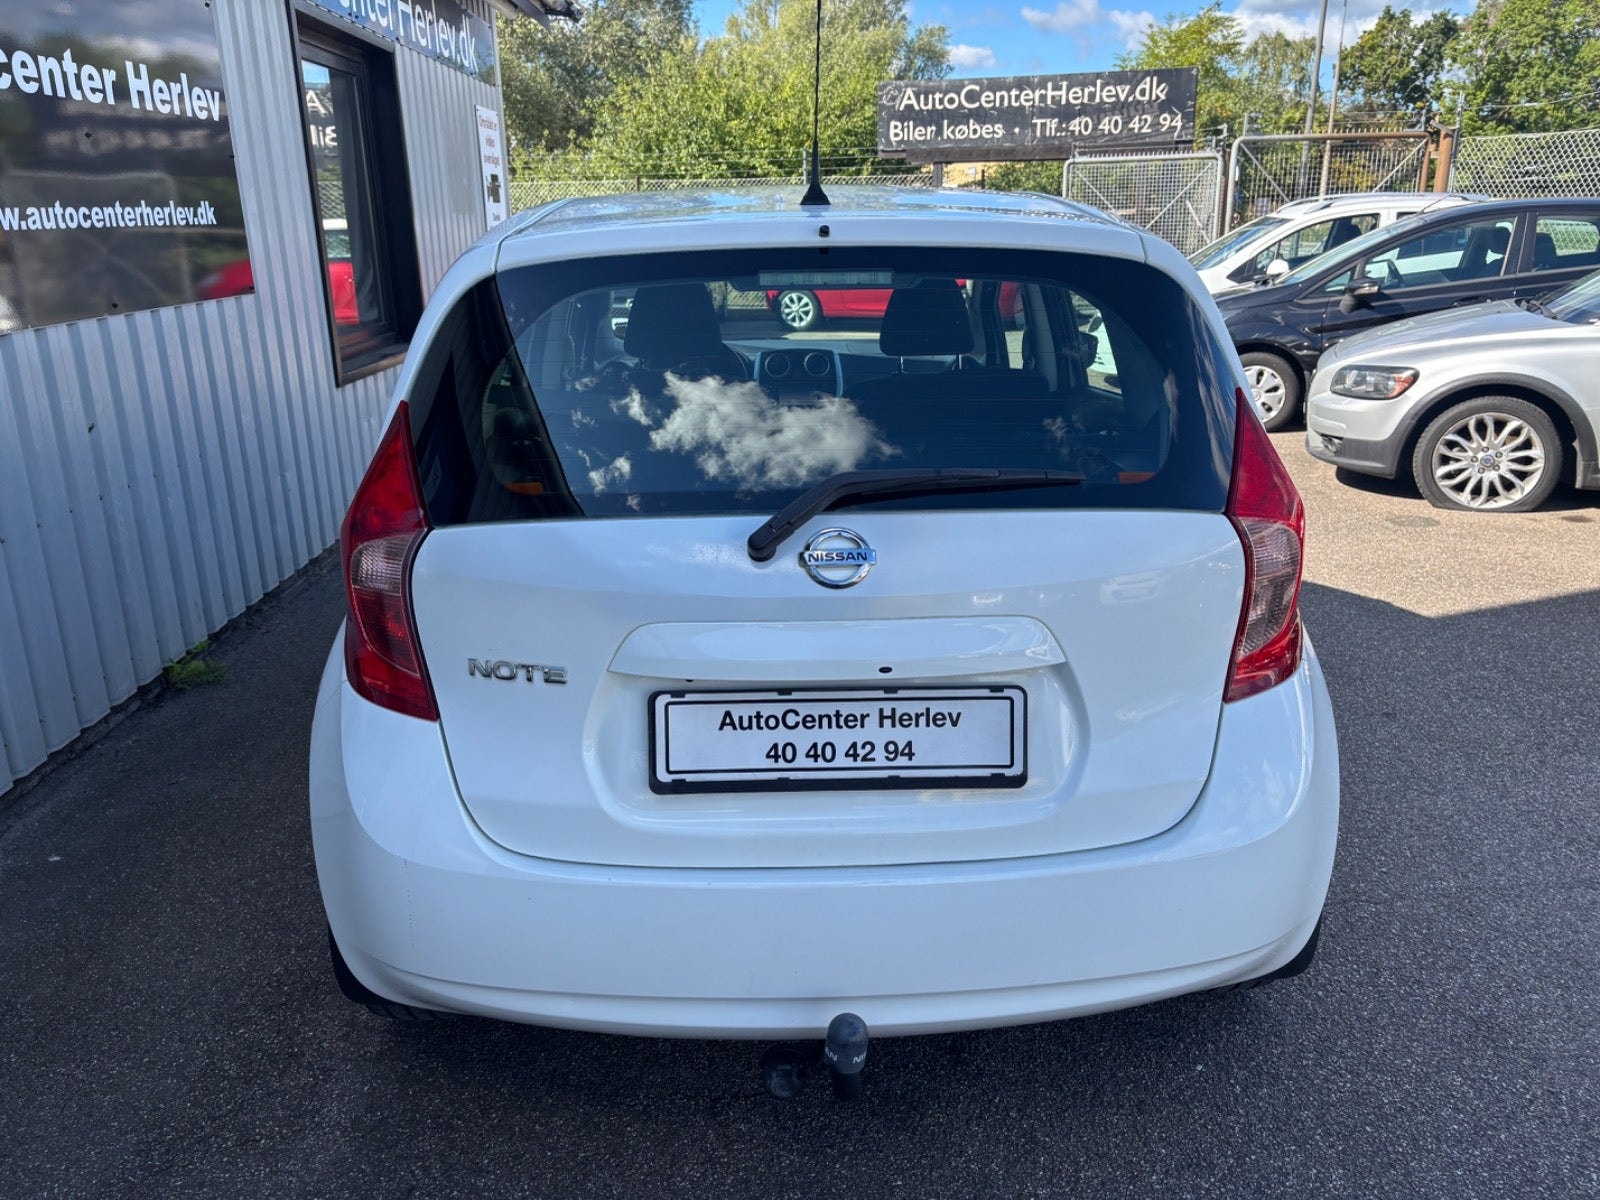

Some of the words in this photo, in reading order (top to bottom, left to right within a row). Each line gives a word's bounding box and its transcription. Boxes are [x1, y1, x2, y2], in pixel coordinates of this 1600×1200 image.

[340, 0, 479, 72] erHerlev.dk
[124, 60, 220, 122] Herlev
[899, 76, 1167, 111] AutoCenterHerlev.dk
[889, 120, 936, 141] Biler
[943, 118, 1004, 140] købes
[1098, 115, 1122, 135] 40
[1128, 114, 1152, 133] 42
[1159, 112, 1183, 133] 94
[807, 551, 868, 563] NISSAN
[467, 657, 568, 685] NOTE
[717, 707, 871, 731] AutoCenter
[878, 706, 962, 729] Herlev
[765, 742, 797, 763] 40
[804, 741, 837, 763] 40
[844, 741, 876, 763] 42
[883, 740, 916, 762] 94
